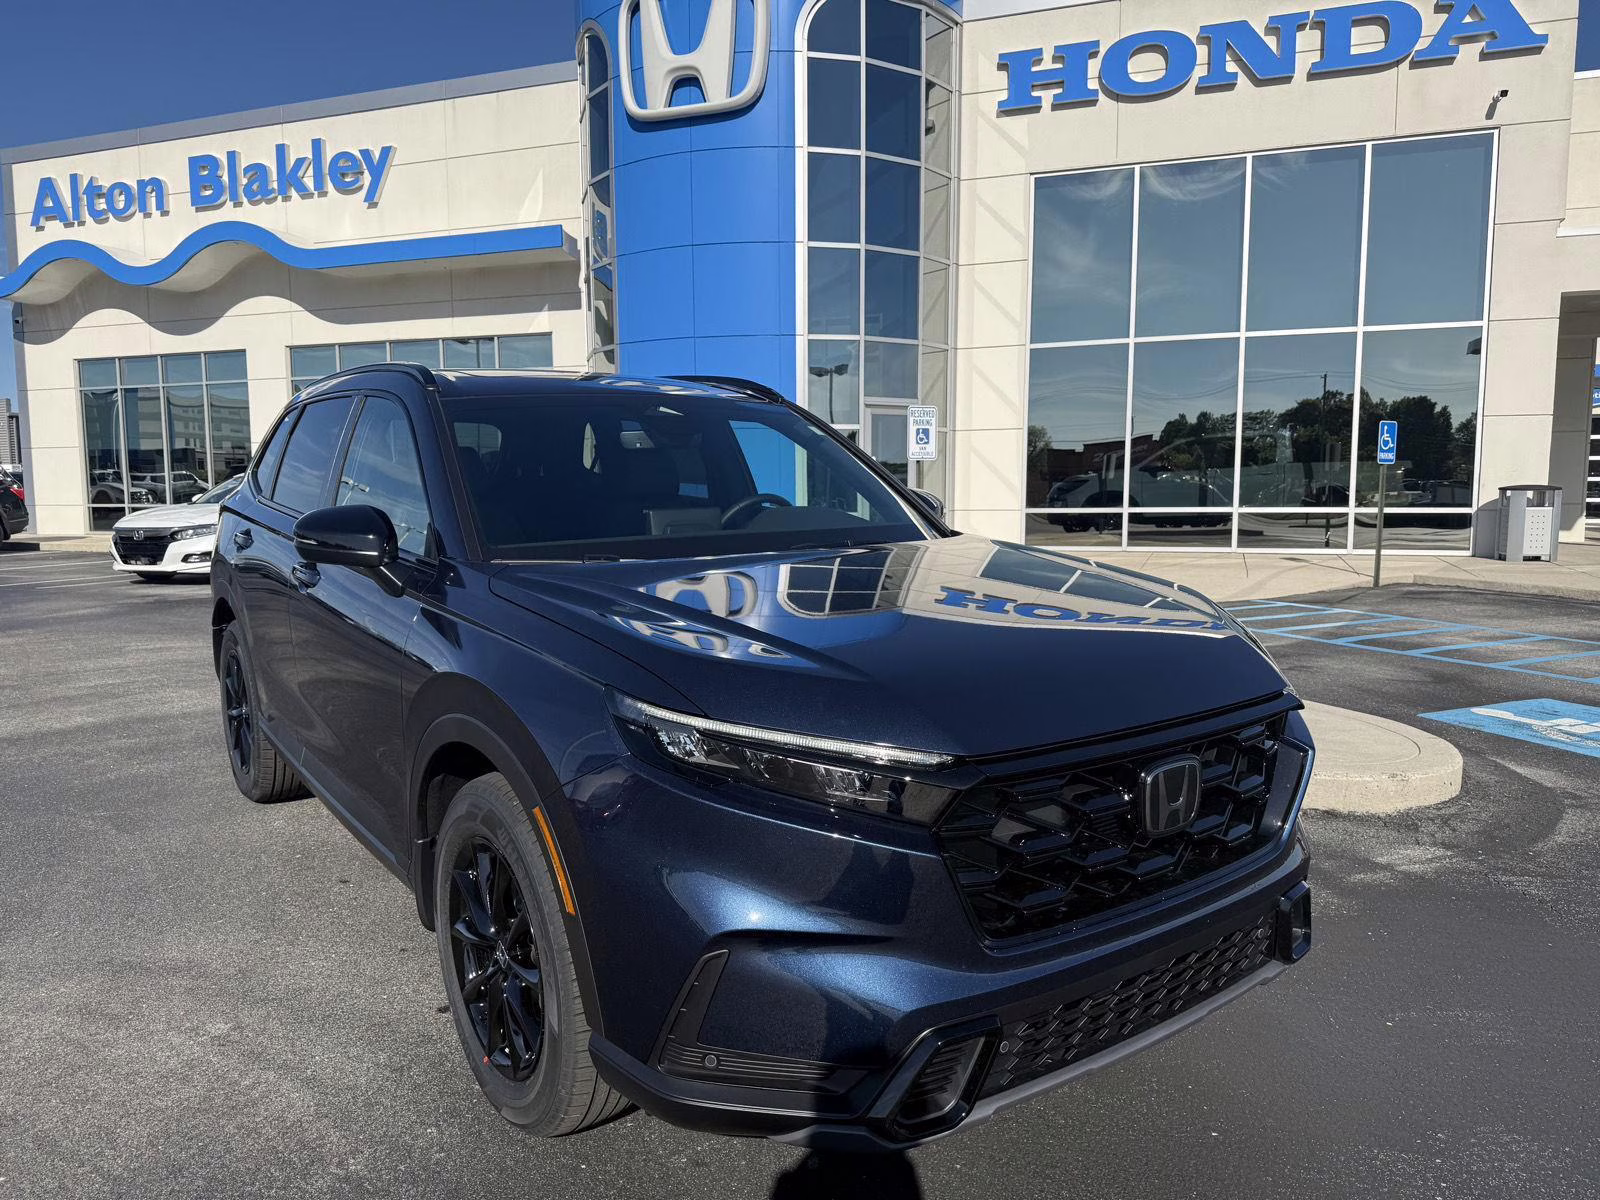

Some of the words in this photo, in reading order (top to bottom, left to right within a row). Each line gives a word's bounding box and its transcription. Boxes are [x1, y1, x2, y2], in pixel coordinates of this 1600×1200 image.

[997, 0, 1549, 111] HONDA
[30, 172, 170, 230] Alton
[188, 138, 396, 209] Blakley
[910, 409, 935, 418] RESERVED
[912, 418, 933, 426] PARKING
